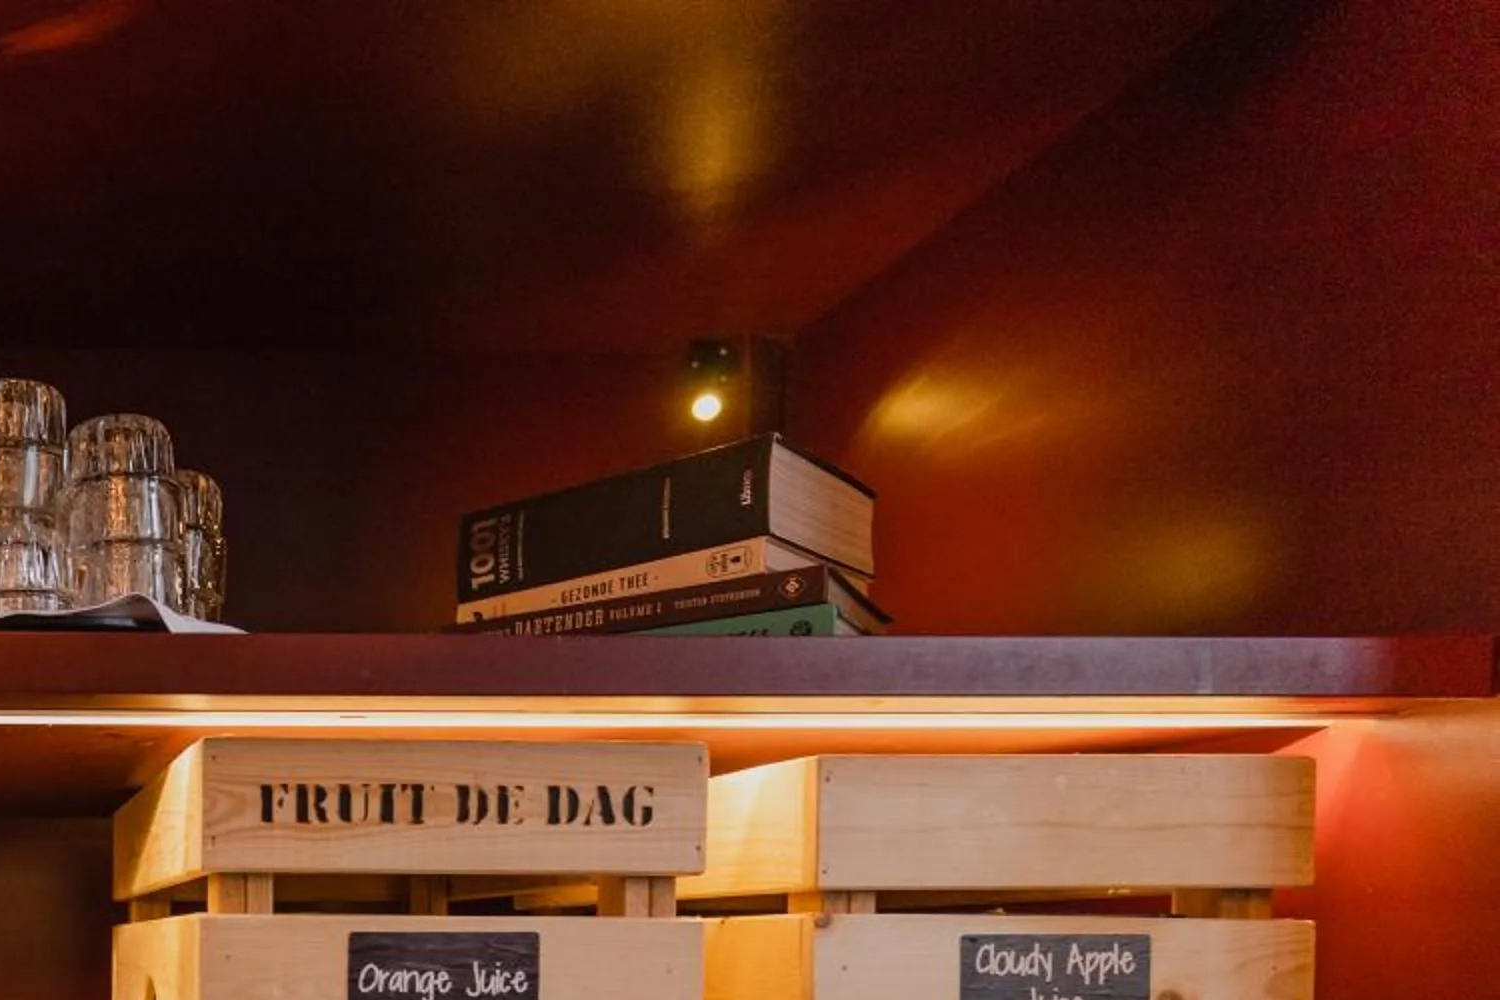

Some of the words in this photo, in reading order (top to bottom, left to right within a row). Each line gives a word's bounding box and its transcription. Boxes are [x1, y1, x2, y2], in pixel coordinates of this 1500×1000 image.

[469, 518, 498, 591] 1001
[560, 579, 614, 604] GEZONDE
[618, 571, 649, 591] THEE
[259, 783, 435, 824] FRUIT
[456, 784, 525, 826] DE
[546, 784, 655, 827] DAG
[465, 960, 530, 998] Juice
[974, 941, 1054, 983] Cloudy
[1065, 941, 1137, 985] Apple
